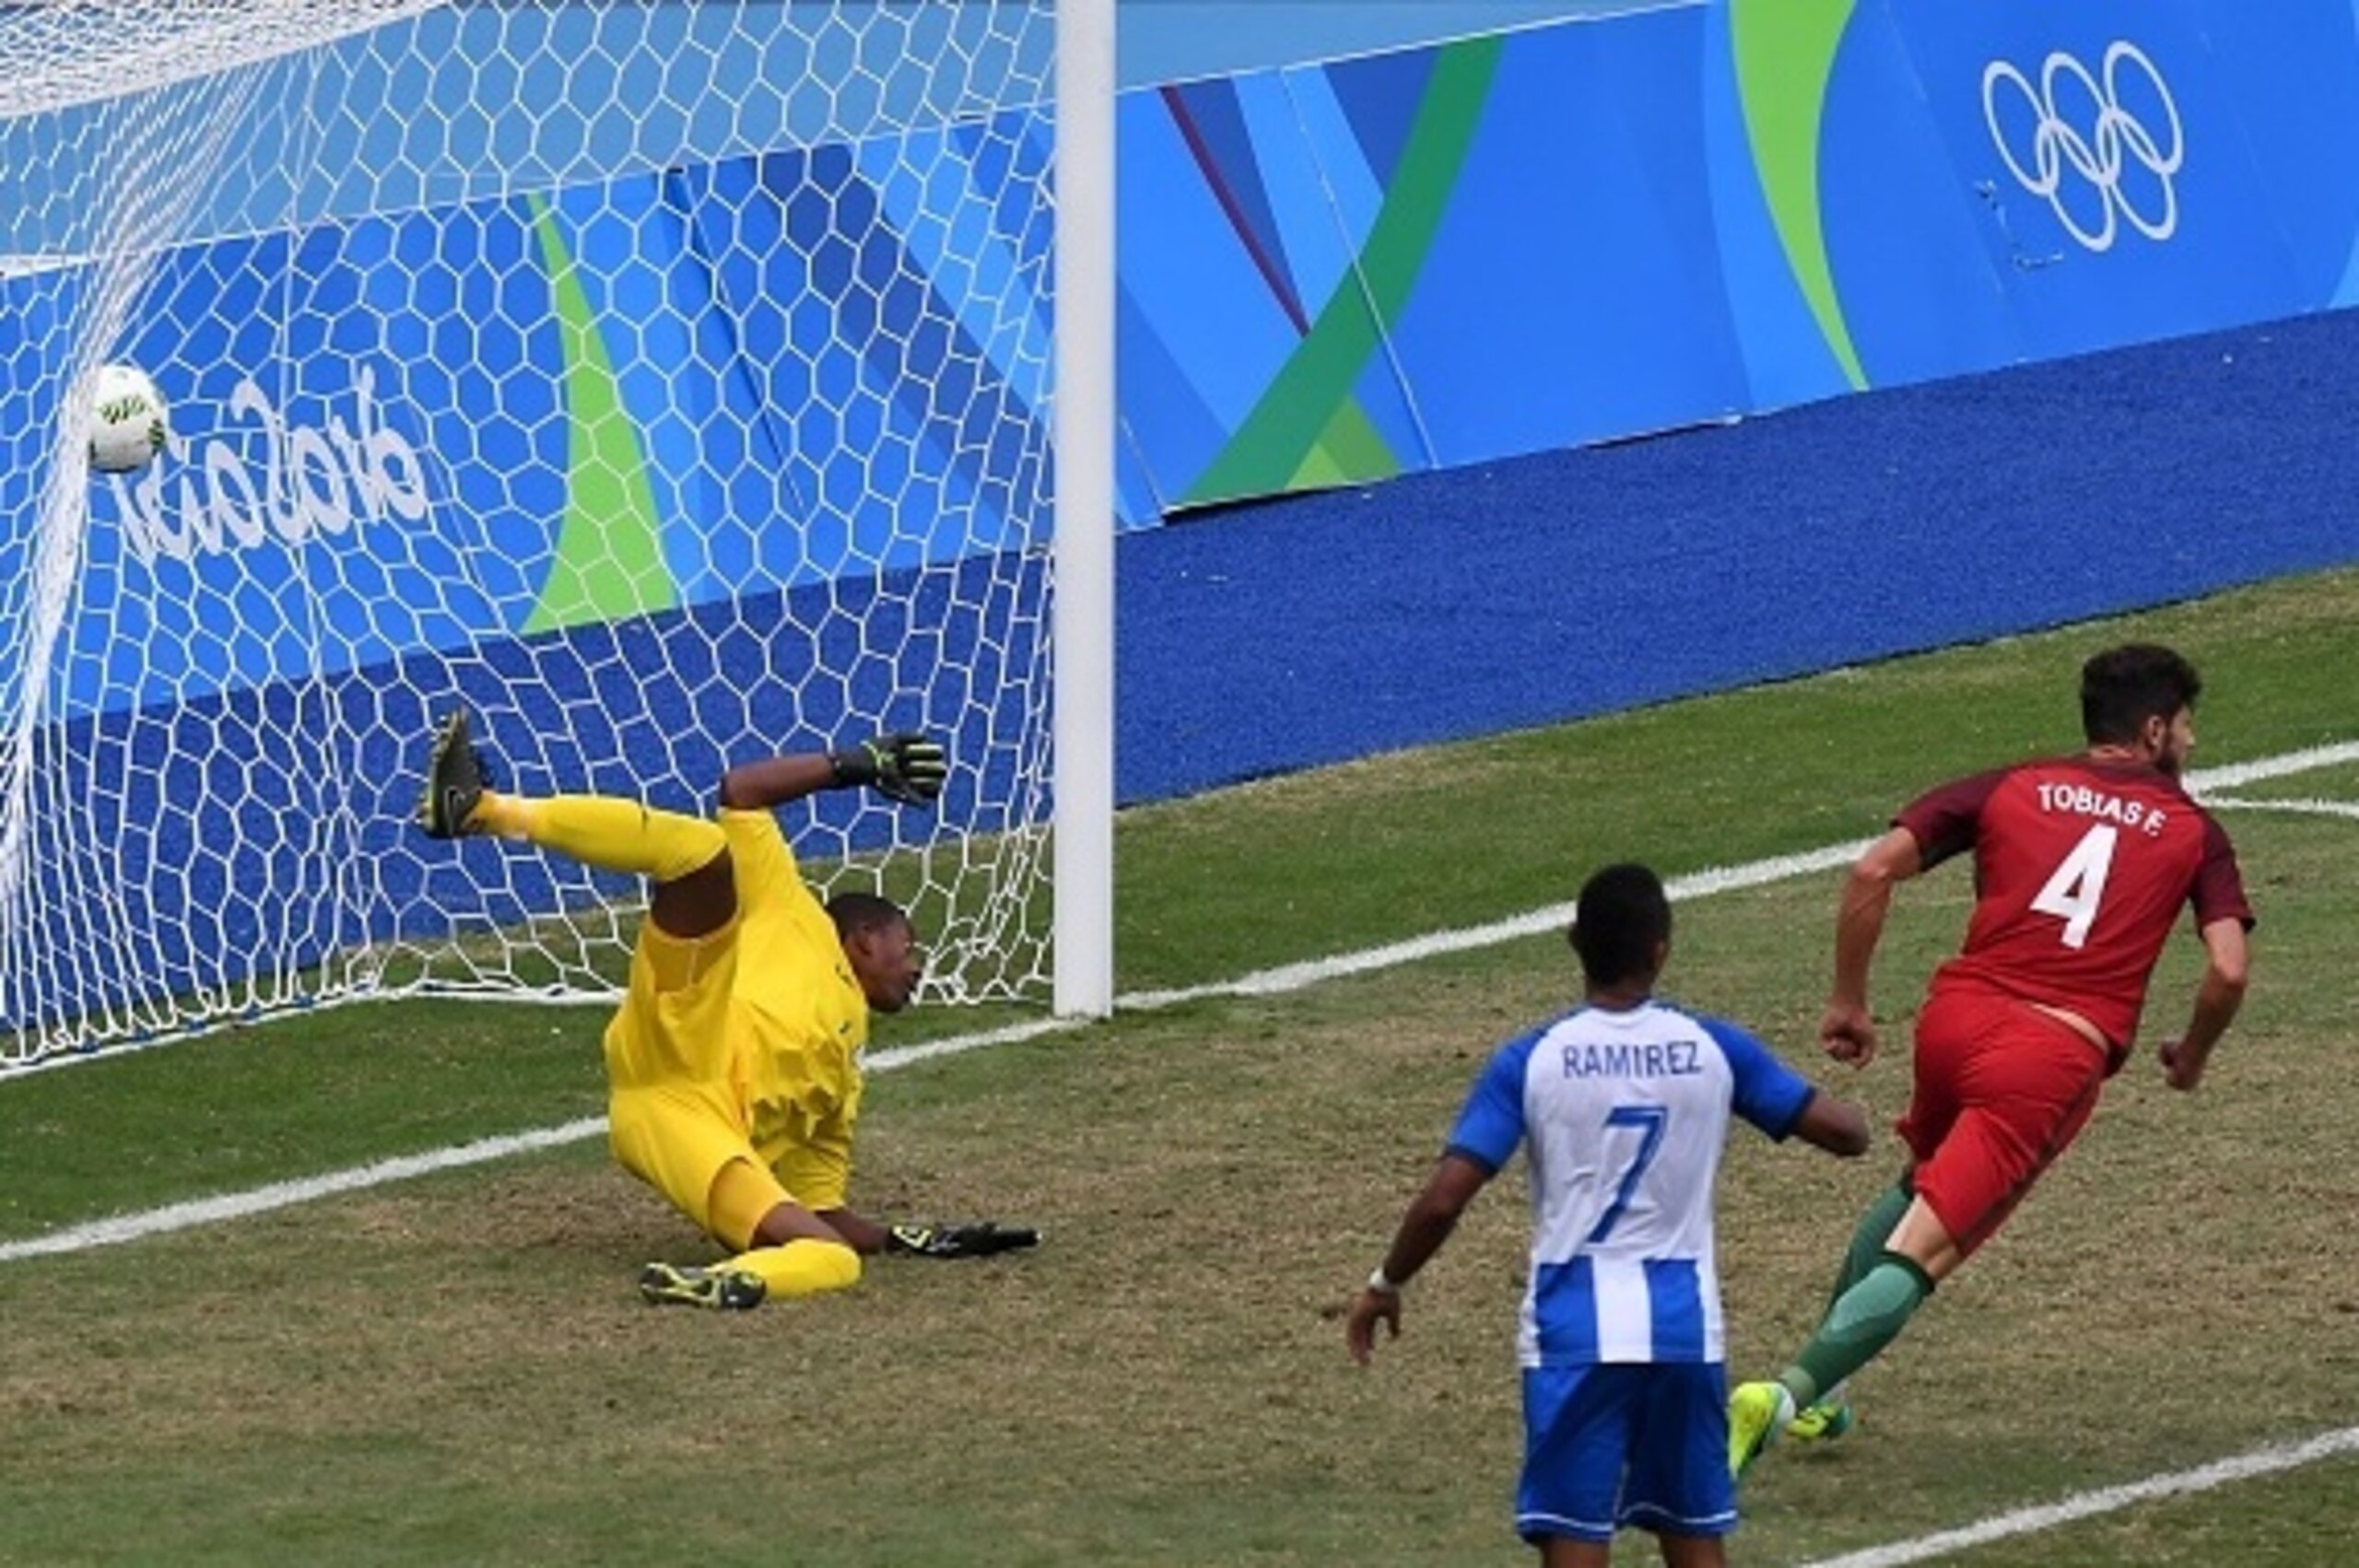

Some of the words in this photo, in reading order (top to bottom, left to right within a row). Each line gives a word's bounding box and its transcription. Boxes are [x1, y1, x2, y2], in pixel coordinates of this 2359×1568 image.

[2037, 784, 2142, 825] TOBIAS
[2029, 823, 2118, 949] 4
[1562, 1040, 1702, 1079] RAMIREZ
[1586, 1106, 1669, 1243] 7
